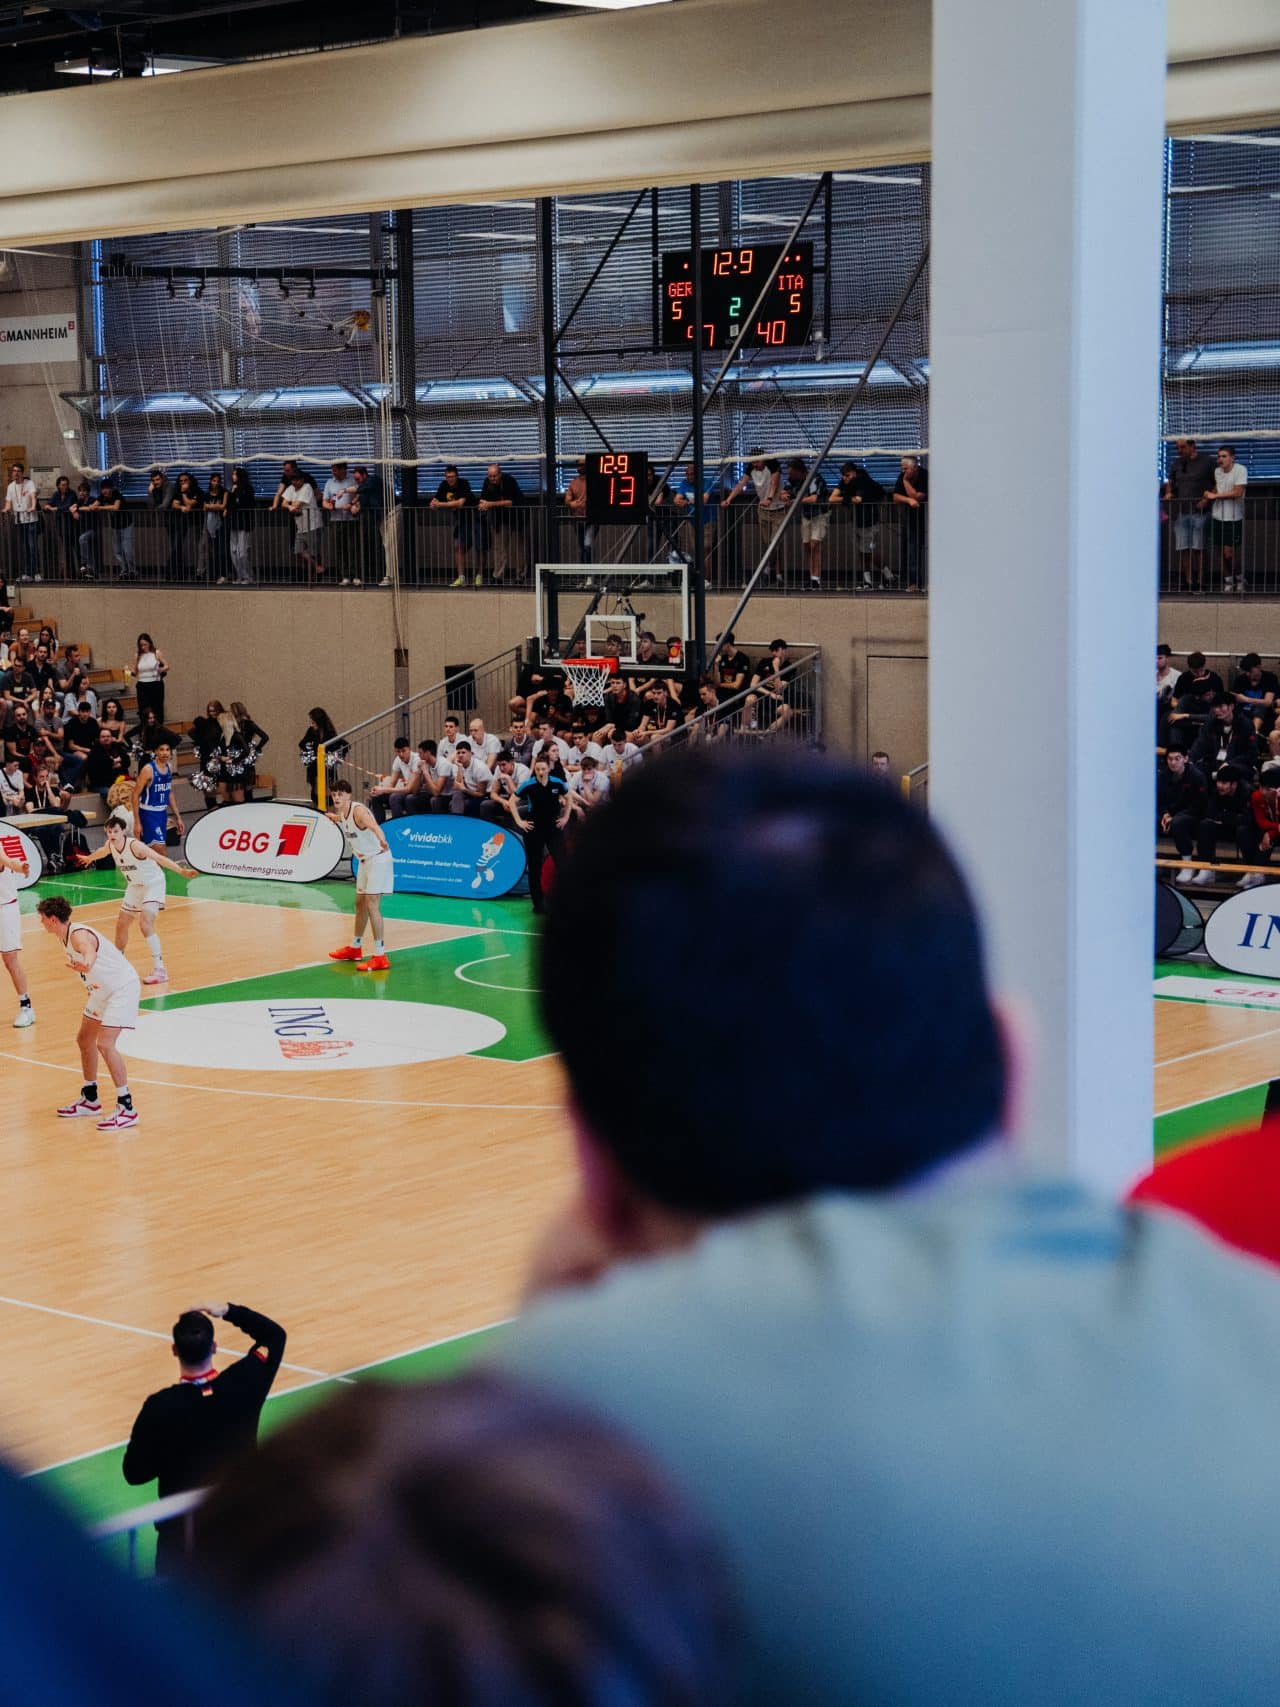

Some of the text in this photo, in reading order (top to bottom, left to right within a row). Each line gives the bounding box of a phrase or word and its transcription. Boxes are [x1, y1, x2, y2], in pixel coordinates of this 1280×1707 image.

[713, 250, 753, 275] 12.9
[668, 281, 693, 297] GER
[778, 274, 804, 291] ITA
[671, 301, 683, 320] 5
[729, 297, 741, 317] 2
[789, 293, 801, 313] 5
[757, 320, 786, 344] 40
[600, 455, 628, 474] 12.9
[610, 476, 635, 505] 13
[218, 828, 271, 854] GBG
[409, 831, 453, 845] vividabkk
[211, 861, 294, 876] Unternehmensgruppe
[1236, 912, 1280, 950] IN
[268, 1005, 335, 1037] ING
